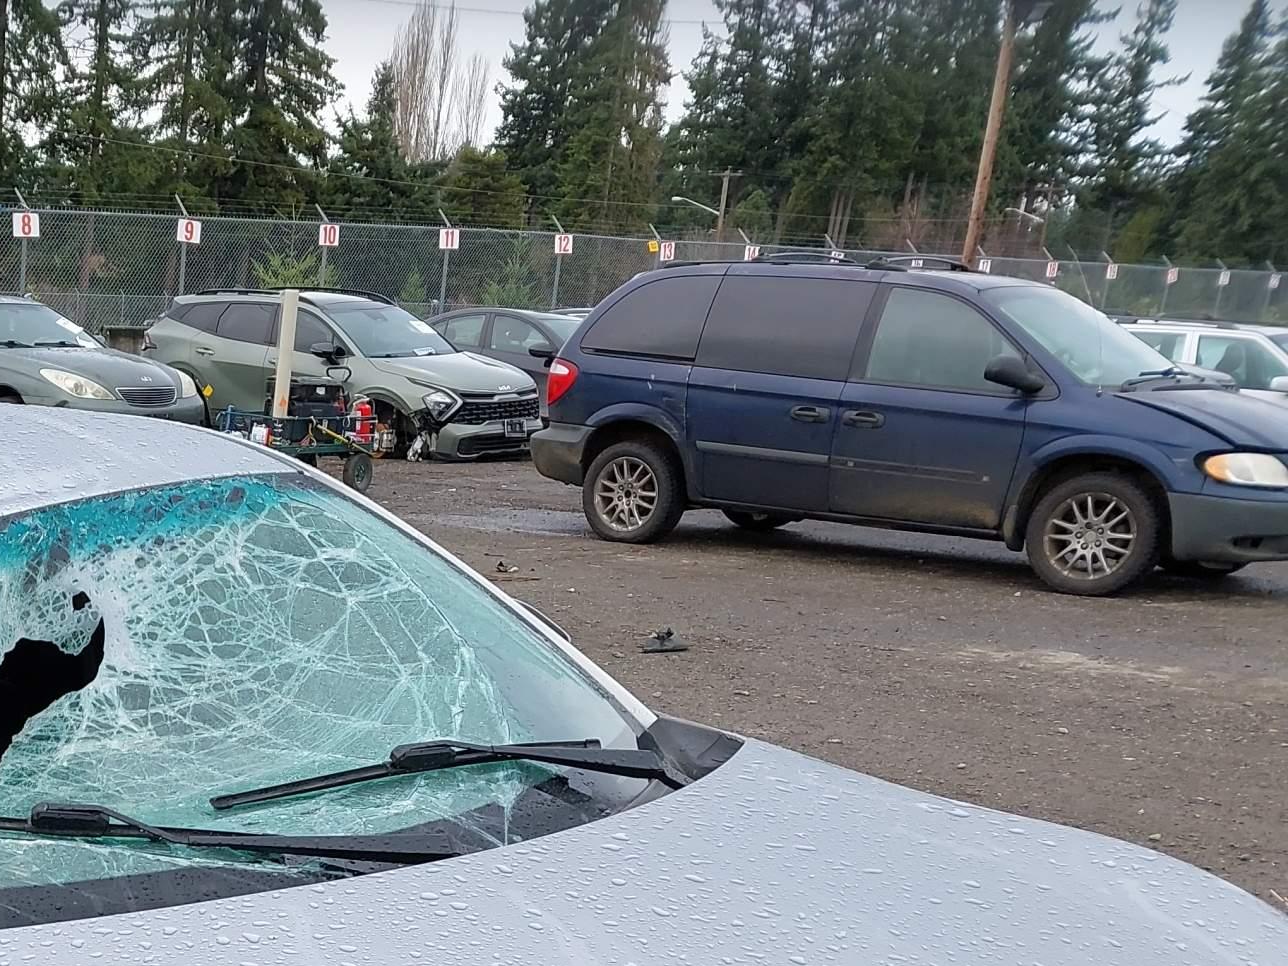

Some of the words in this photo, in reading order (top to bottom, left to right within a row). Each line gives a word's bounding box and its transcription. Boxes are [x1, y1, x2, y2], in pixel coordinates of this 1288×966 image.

[21, 213, 32, 236] 8
[184, 221, 195, 241] 9
[322, 226, 337, 245] 10
[444, 229, 455, 248] 11
[557, 235, 570, 253] 12
[663, 243, 673, 259] 13
